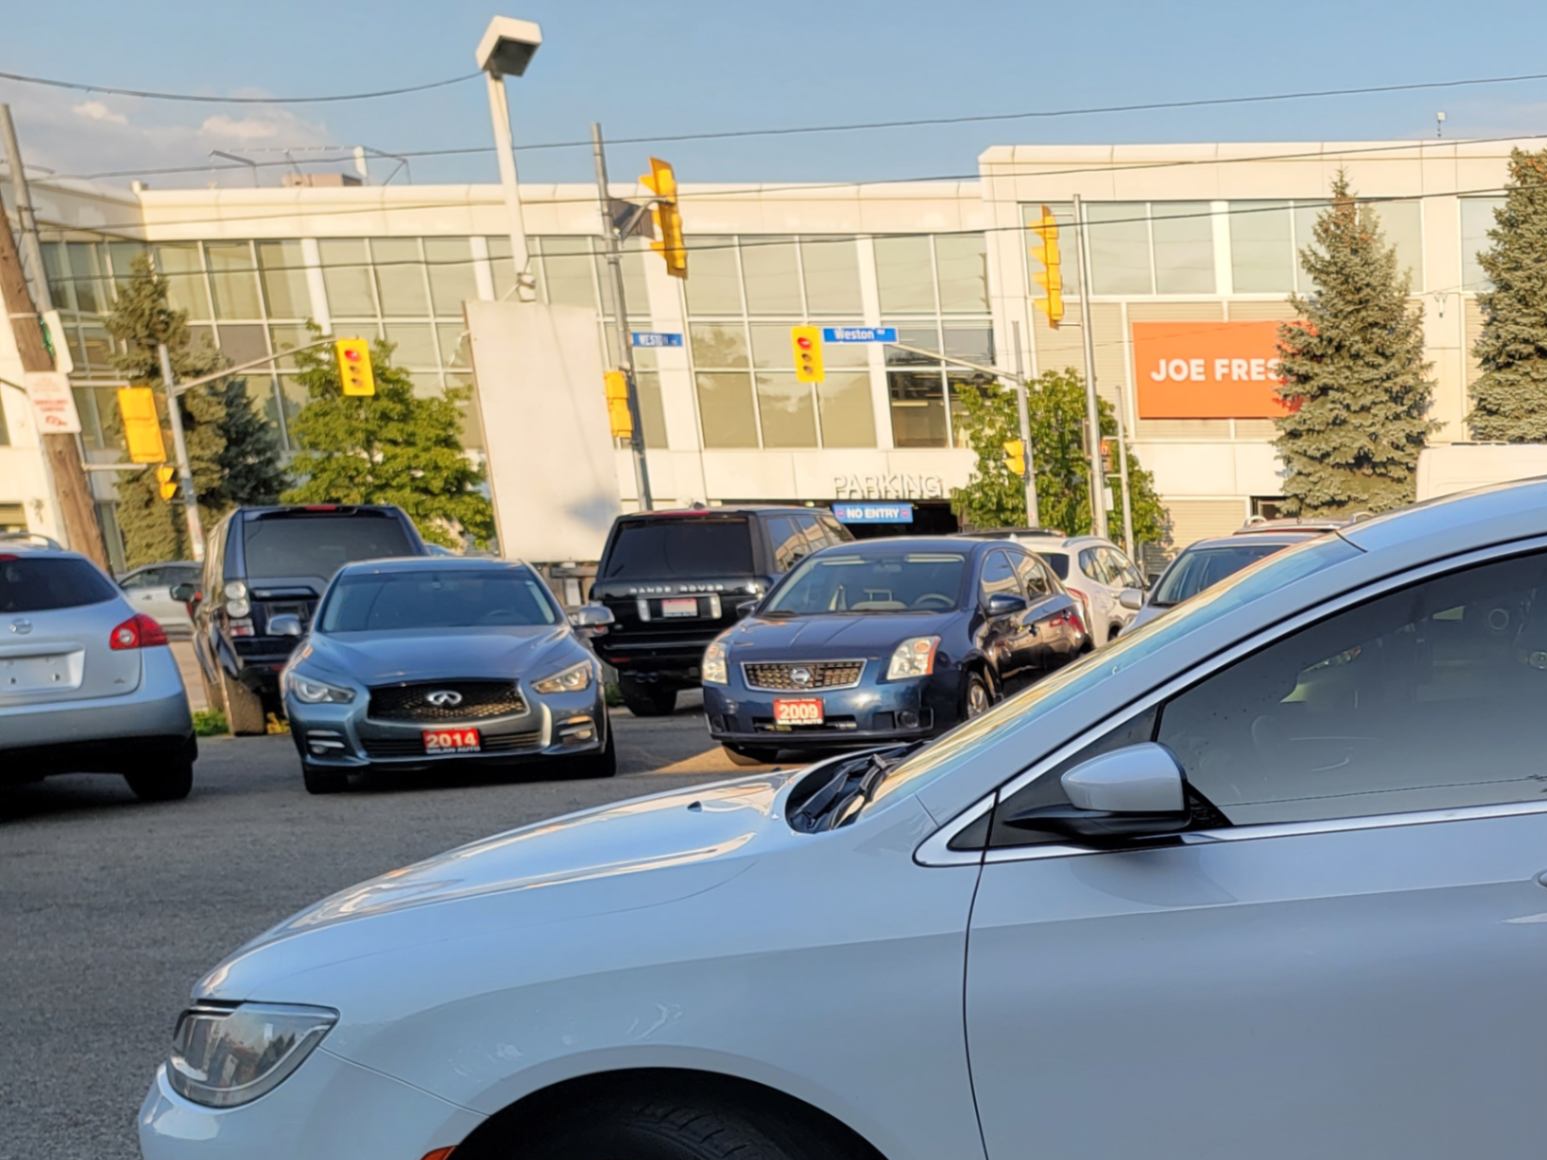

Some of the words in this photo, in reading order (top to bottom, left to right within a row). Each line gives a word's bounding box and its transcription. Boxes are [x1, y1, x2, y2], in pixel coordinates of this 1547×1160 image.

[834, 326, 875, 341] Weston
[1150, 358, 1206, 382] JOE
[1214, 358, 1286, 382] FRES
[834, 474, 944, 500] PARKING
[846, 507, 863, 519] NO
[864, 507, 899, 519] ENTRY
[780, 703, 818, 719] 2009
[427, 732, 477, 748] 2014
